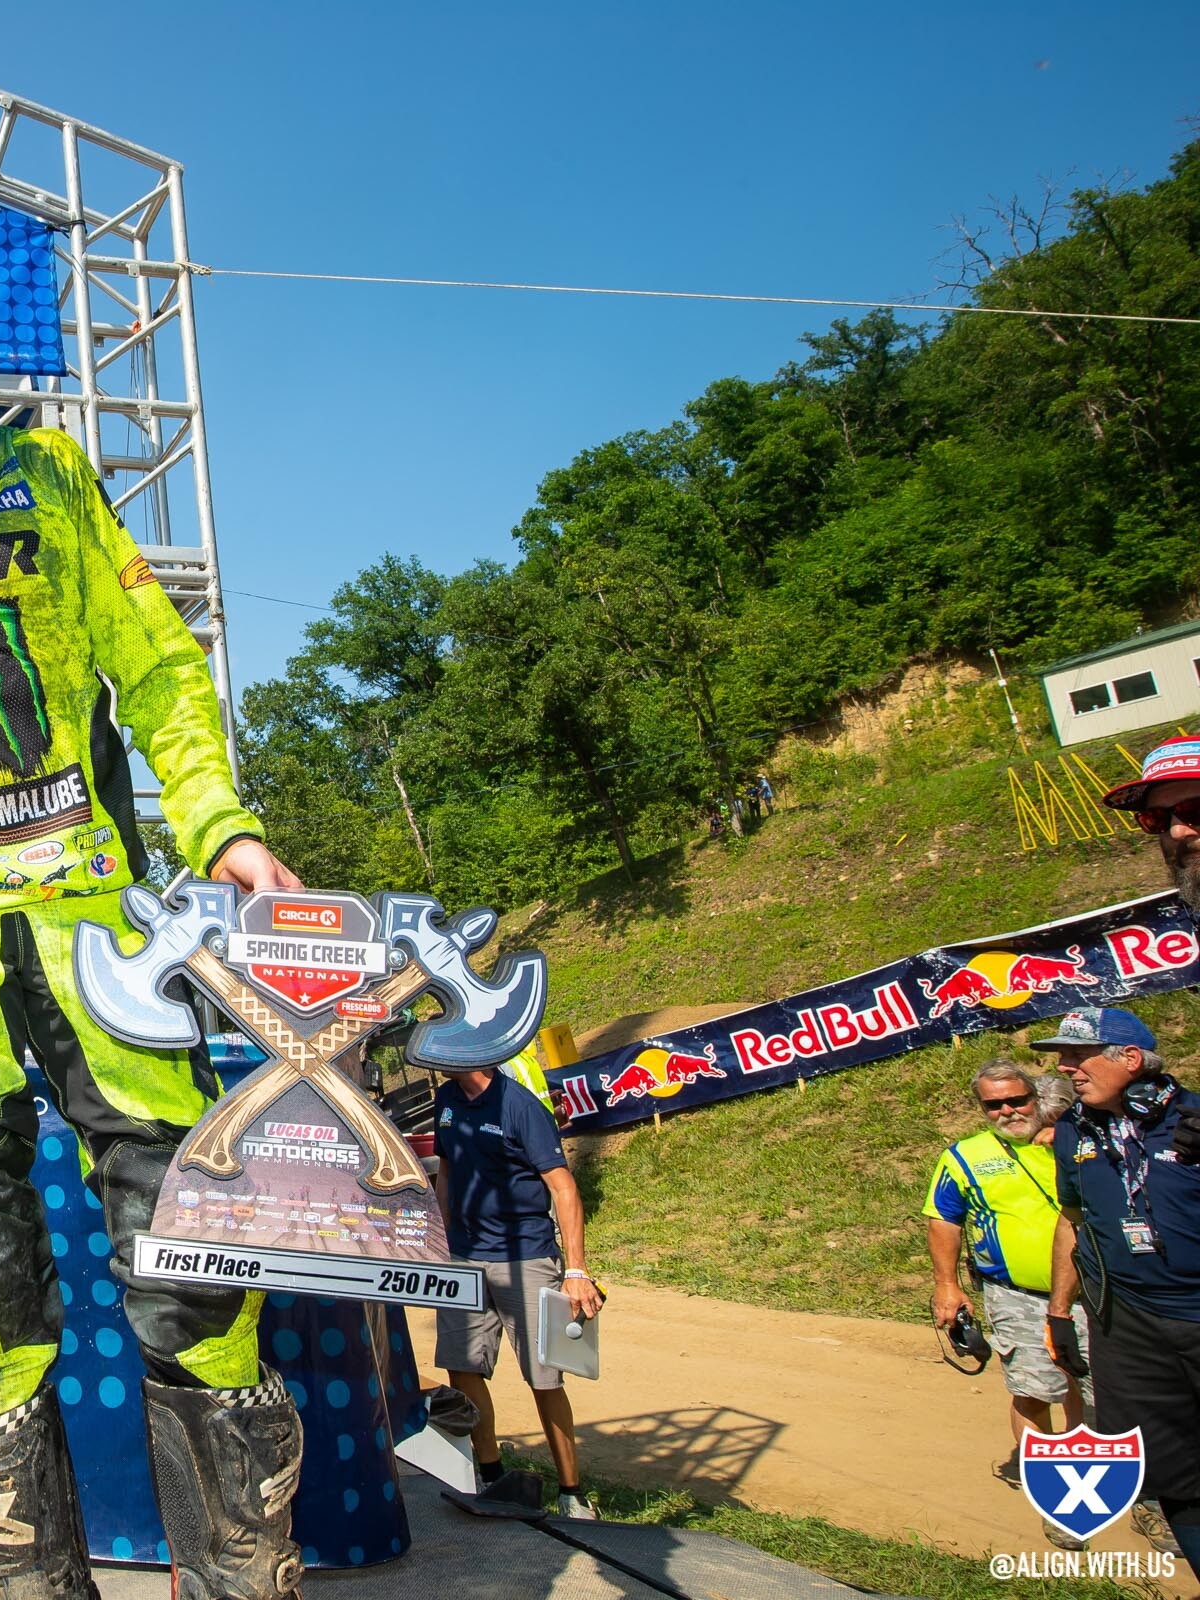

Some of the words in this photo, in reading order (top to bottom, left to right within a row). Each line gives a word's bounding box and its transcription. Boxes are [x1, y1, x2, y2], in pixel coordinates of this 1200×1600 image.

[22, 846, 60, 862] BELL
[278, 909, 318, 922] CIRCLE
[320, 910, 337, 926] K
[246, 940, 308, 961] SPRING
[311, 945, 367, 966] CREEK
[262, 968, 349, 982] NATIONAL
[341, 1002, 382, 1013] FRESCADOS
[730, 1014, 821, 1075] Red
[817, 980, 919, 1050] Bull
[267, 1123, 312, 1139] LUCAS
[313, 1127, 336, 1141] OIL
[242, 1141, 360, 1165] MOTOCROSS
[242, 1155, 360, 1169] CHAMPIONSHIP
[410, 1210, 427, 1219] NBC
[395, 1239, 425, 1247] peacock
[154, 1248, 201, 1273] First
[203, 1253, 261, 1279] Place
[377, 1269, 419, 1295] 250
[423, 1274, 460, 1299] Pro
